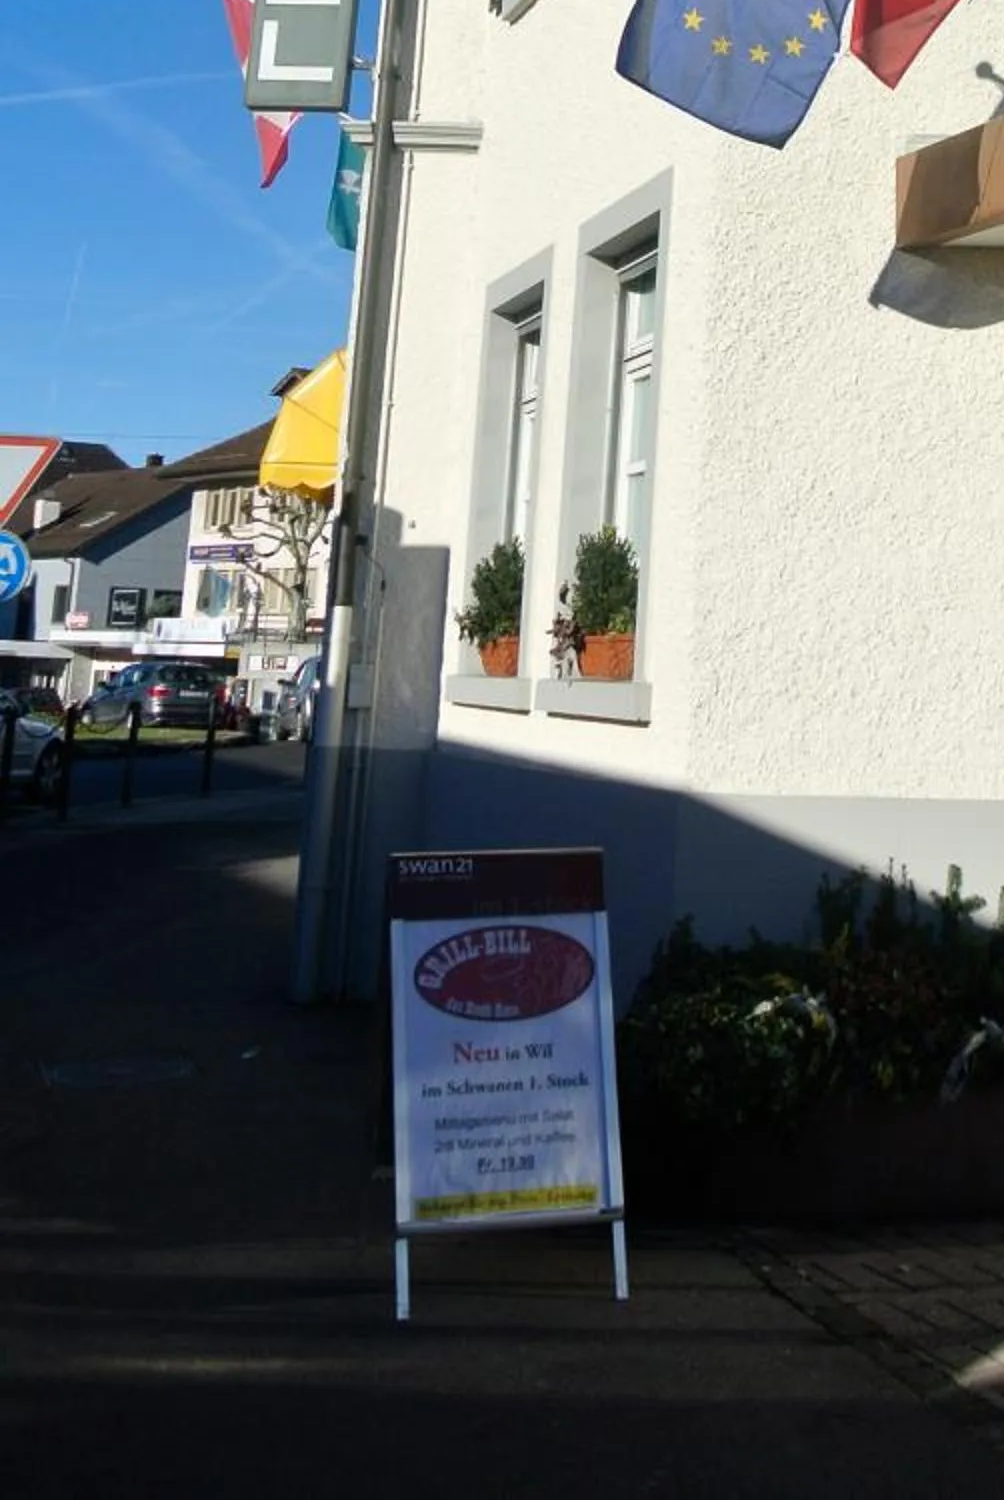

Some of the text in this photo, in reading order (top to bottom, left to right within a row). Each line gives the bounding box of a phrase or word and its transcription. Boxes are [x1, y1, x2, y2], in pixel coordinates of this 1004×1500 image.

[399, 857, 473, 876] swan21
[452, 1041, 499, 1064] Neu
[505, 1046, 520, 1061] in
[421, 1083, 442, 1098] im
[446, 1078, 524, 1096] Schwanen
[546, 1071, 590, 1089] Stock
